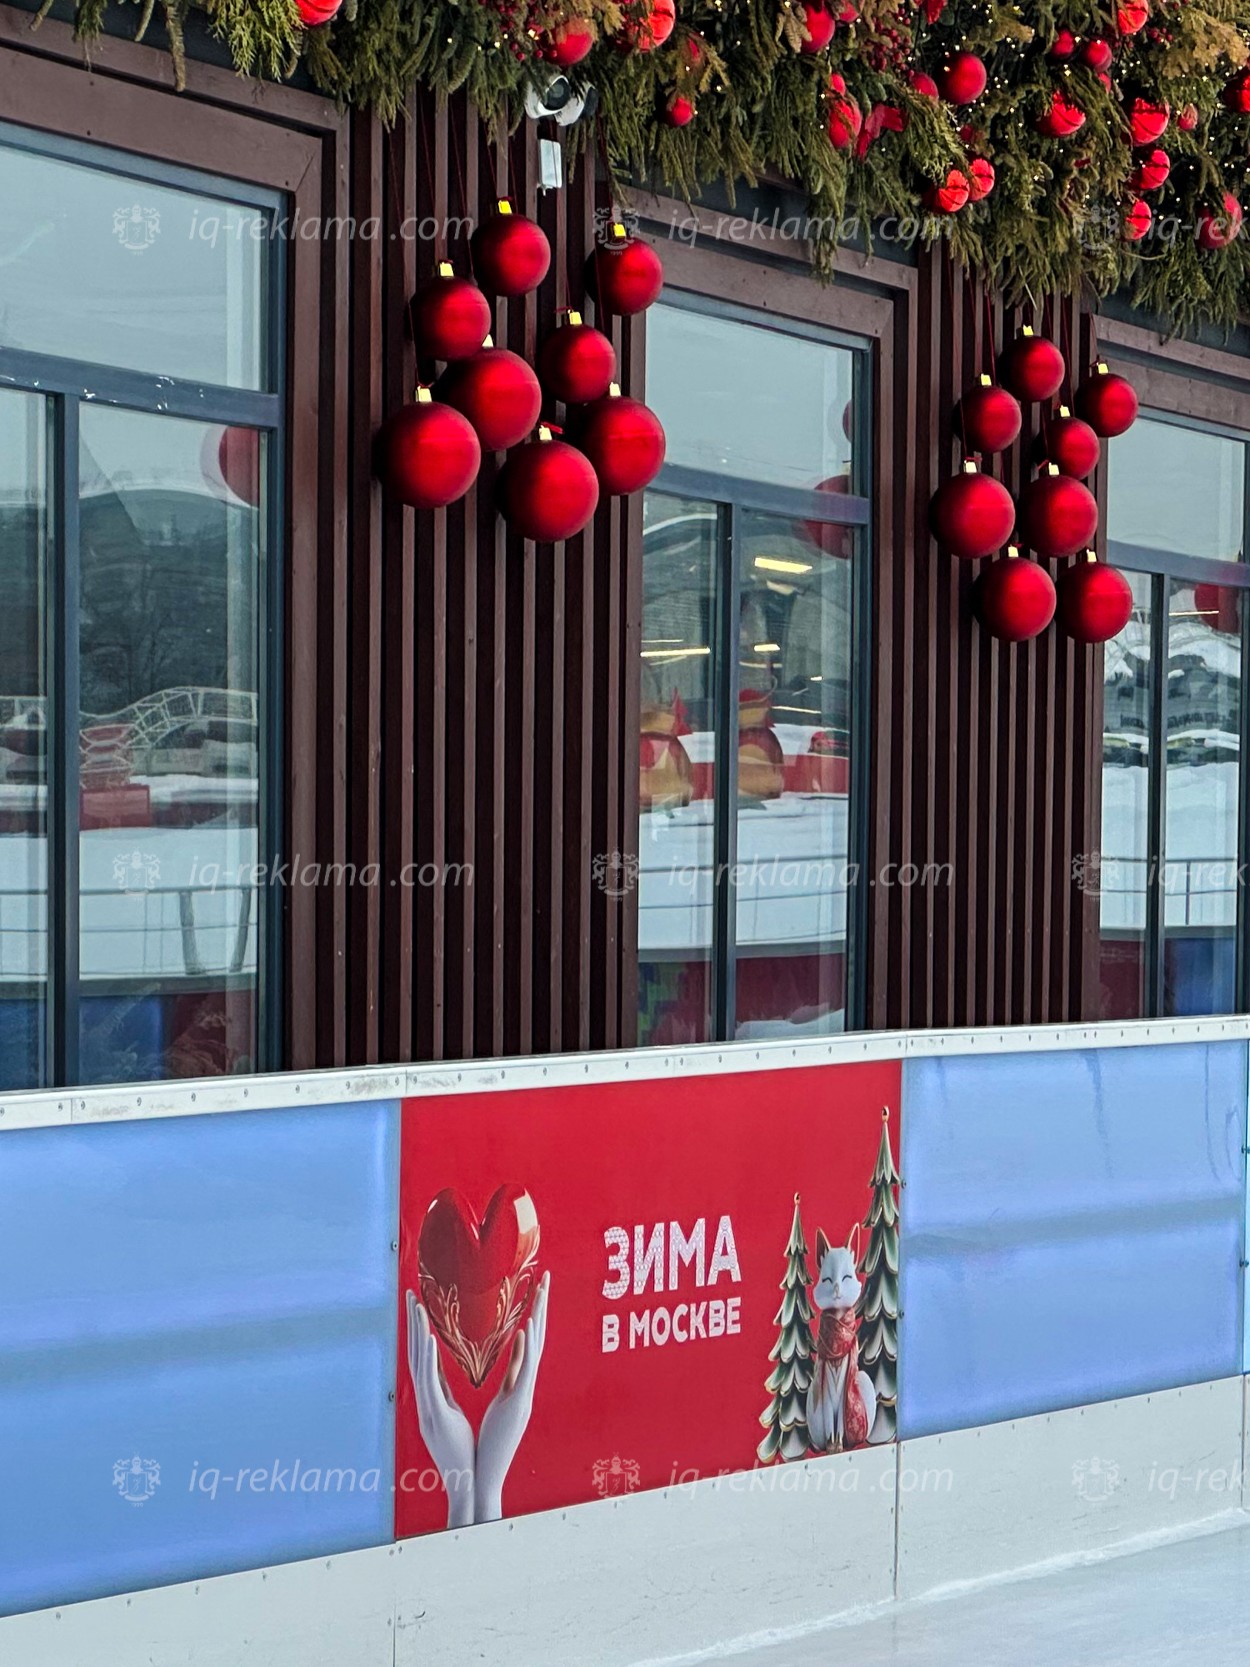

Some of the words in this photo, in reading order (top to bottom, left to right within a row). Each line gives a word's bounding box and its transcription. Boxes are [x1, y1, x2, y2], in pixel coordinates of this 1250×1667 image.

[602, 1215, 742, 1300] ЗИМА
[602, 1313, 620, 1353] В
[628, 1297, 742, 1350] МОСКВЕ
